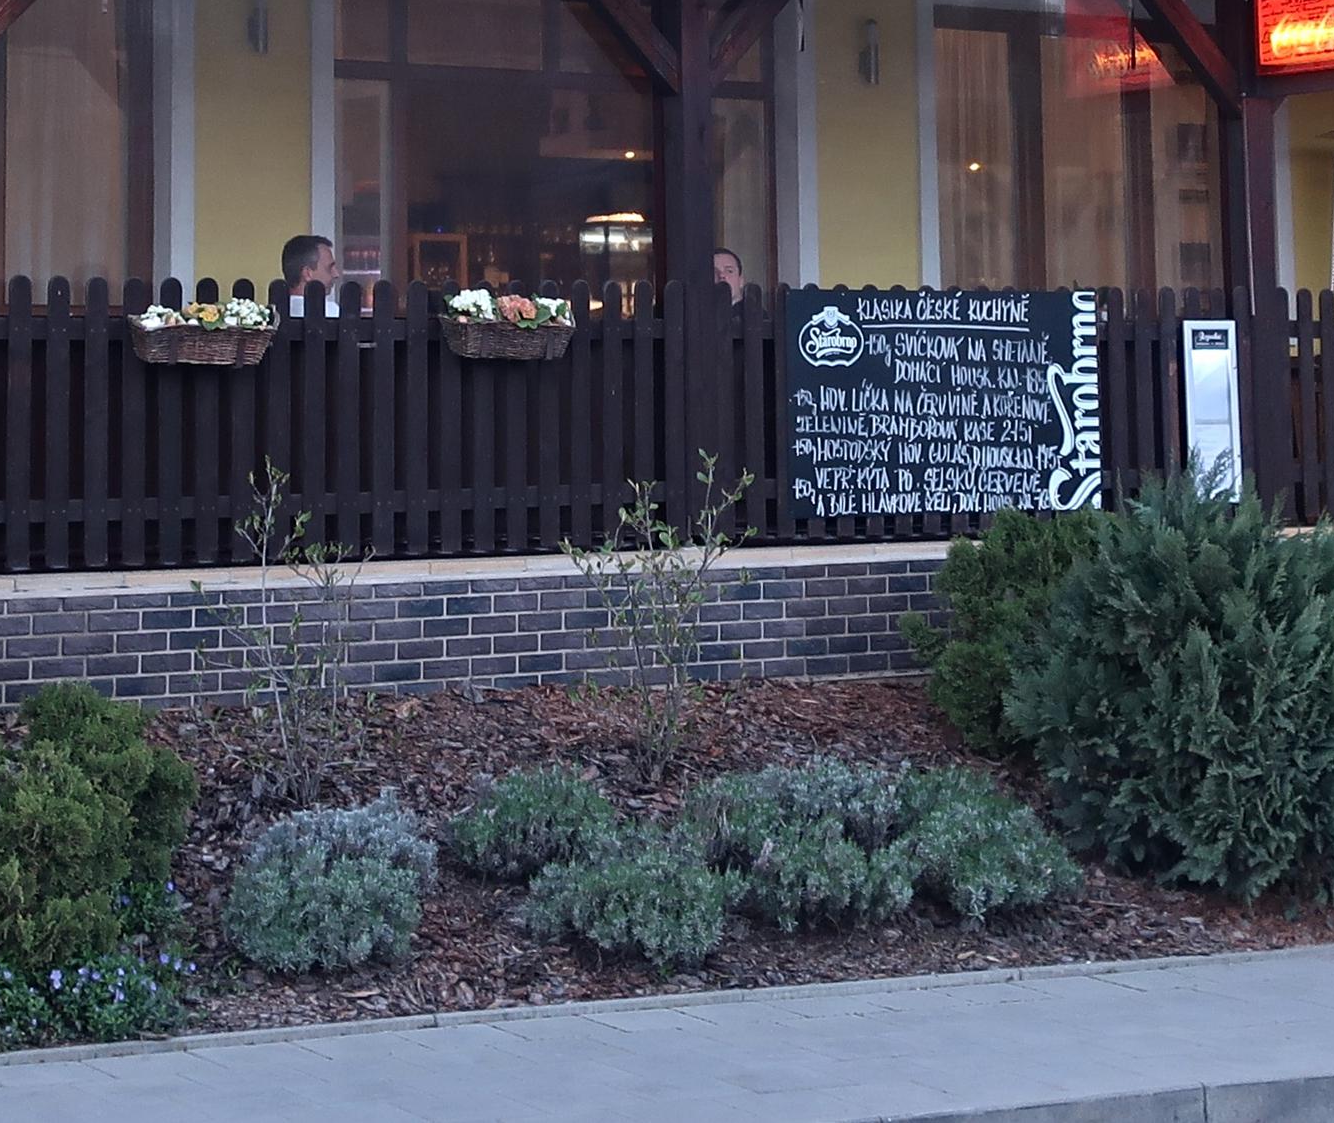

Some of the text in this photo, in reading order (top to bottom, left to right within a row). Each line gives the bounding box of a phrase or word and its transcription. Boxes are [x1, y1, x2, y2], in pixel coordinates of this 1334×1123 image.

[857, 291, 1030, 323] KLASIKA ČESKÉ KUCHYNĚ
[805, 327, 858, 356] Starobrno
[895, 330, 965, 361] SVÍČKOVÁ
[968, 337, 987, 362] NA
[951, 364, 996, 389] HOUSK.
[820, 385, 848, 412] HOV.
[852, 378, 889, 412] LÍČKA
[894, 389, 914, 416] NA
[1047, 291, 1102, 510] Starobrno
[898, 441, 924, 465] HOV.
[857, 462, 890, 491] KÝTA
